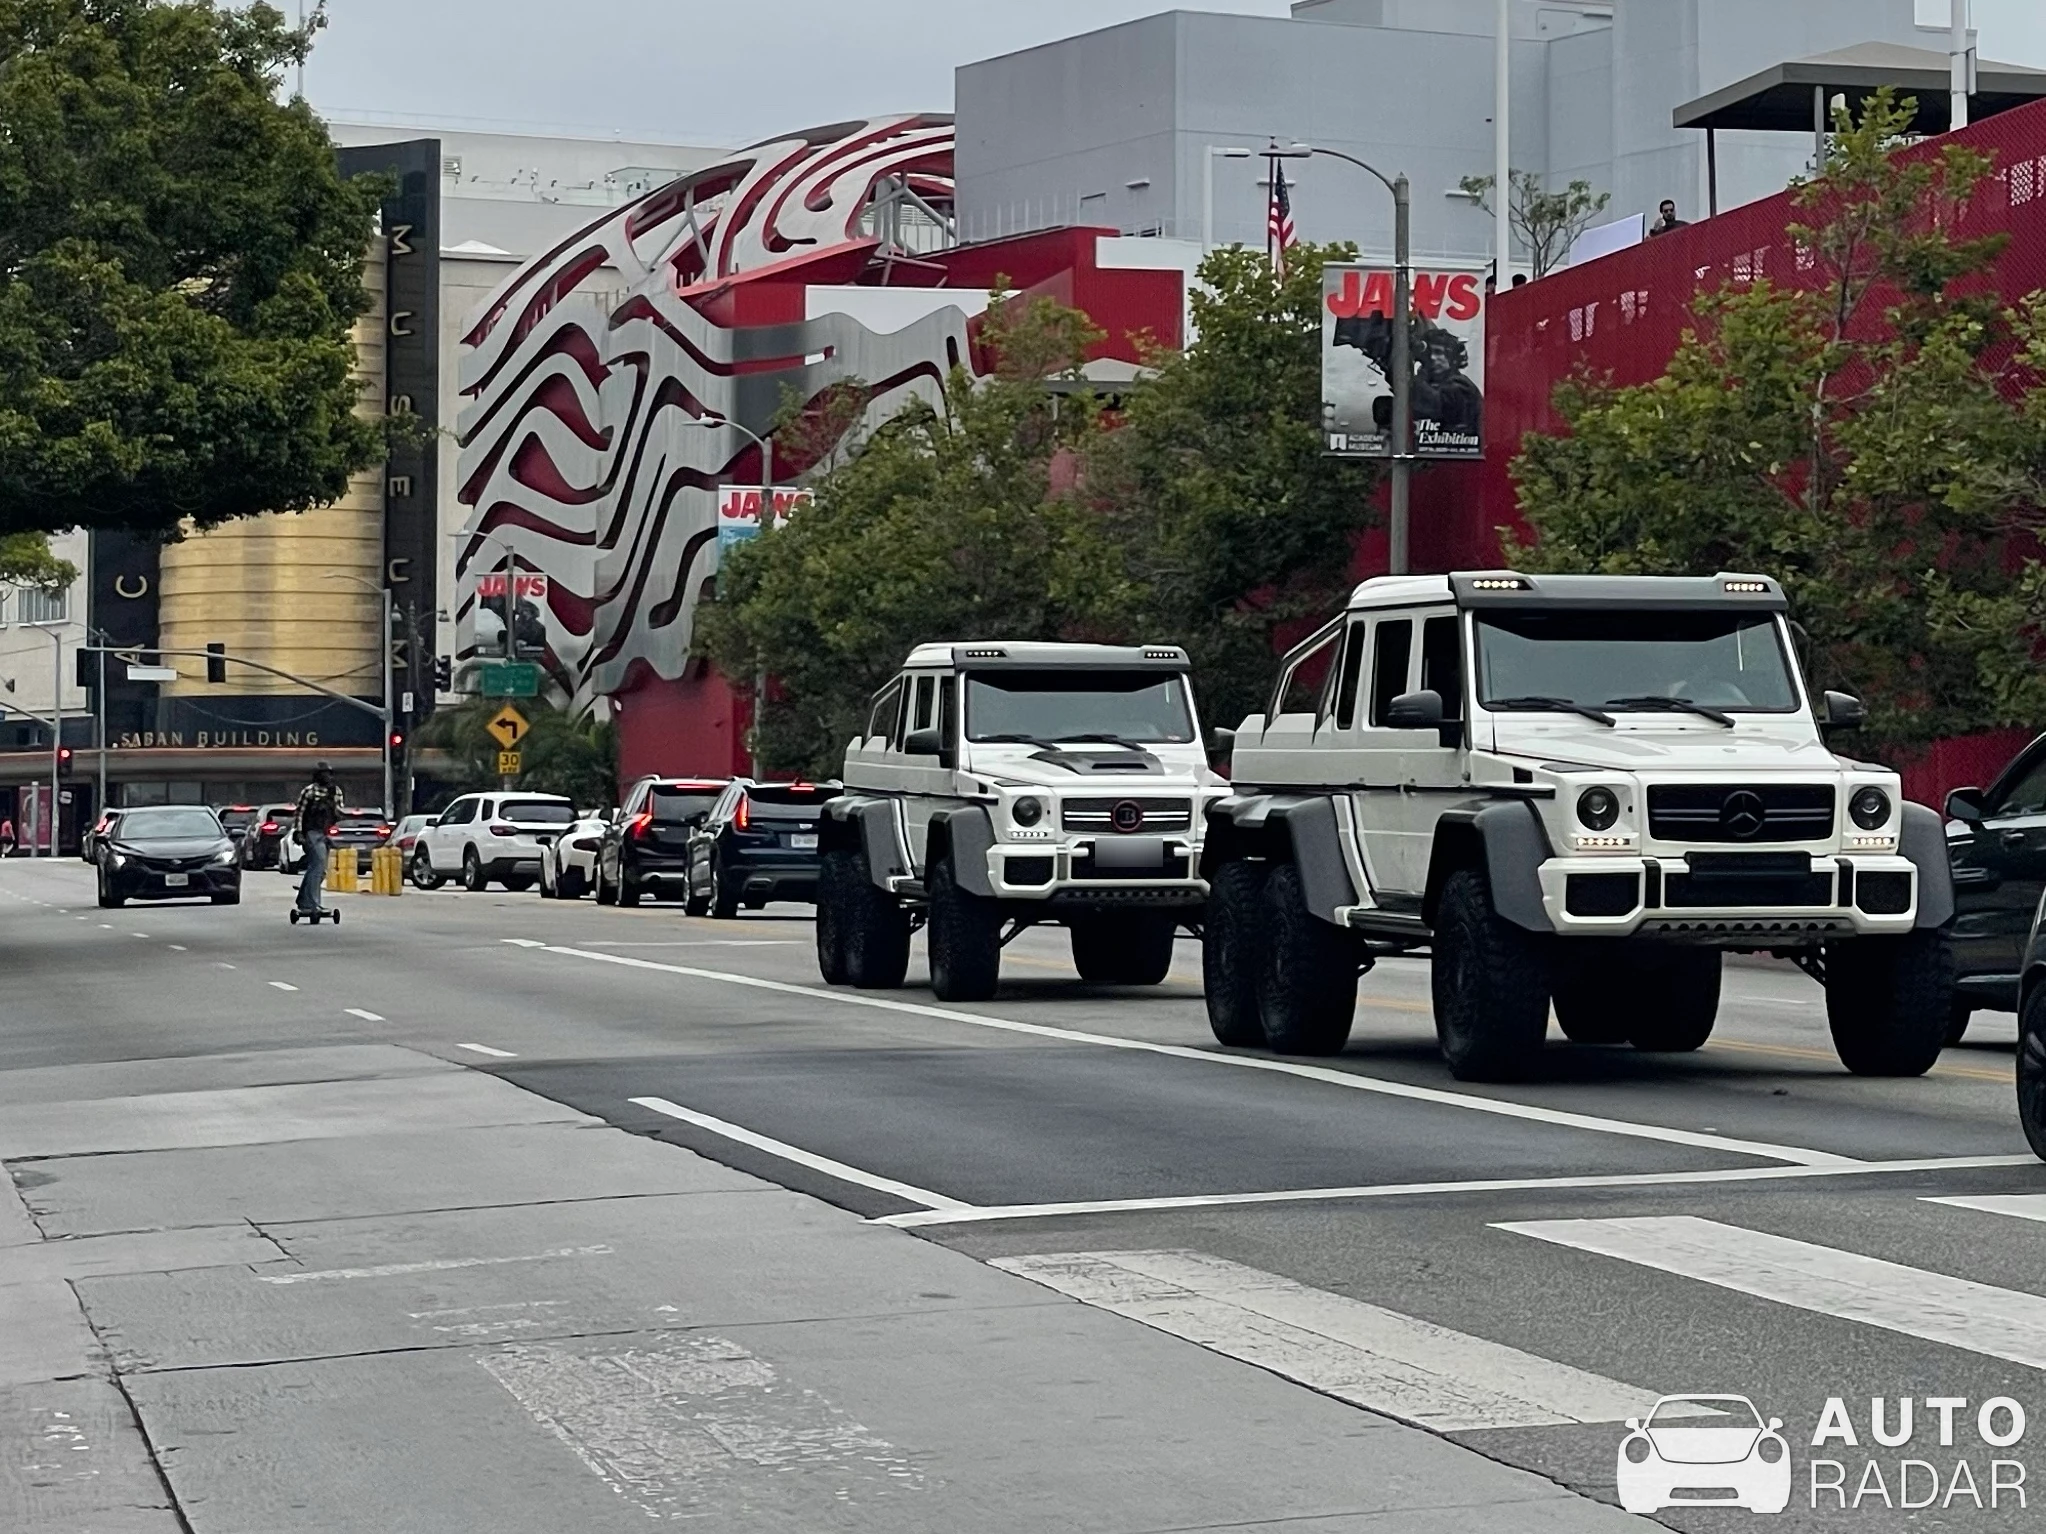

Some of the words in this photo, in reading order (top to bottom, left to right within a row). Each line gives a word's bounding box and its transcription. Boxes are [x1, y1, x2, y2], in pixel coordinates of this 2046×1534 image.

[1326, 271, 1481, 320] JAWS
[1419, 418, 1441, 431] The
[1418, 432, 1479, 446] Exhibition
[476, 575, 546, 597] JAWS
[121, 731, 183, 747] SABAN
[197, 731, 319, 747] BUILDING
[501, 753, 519, 766] 30
